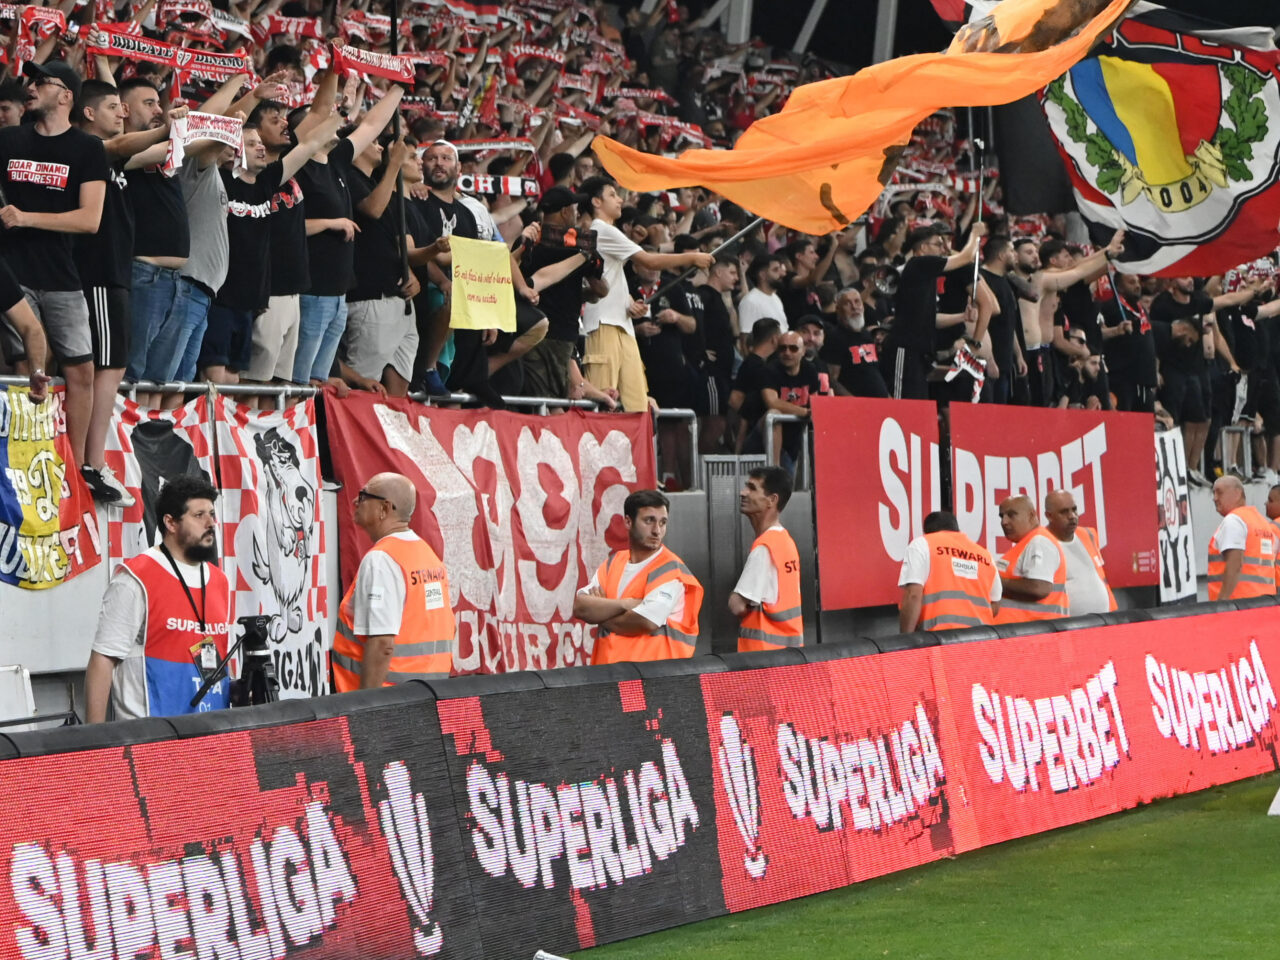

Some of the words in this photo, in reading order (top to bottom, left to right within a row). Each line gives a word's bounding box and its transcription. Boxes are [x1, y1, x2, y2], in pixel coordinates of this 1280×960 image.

[194, 53, 245, 69] DINAMO
[8, 159, 33, 171] DOAR
[35, 162, 68, 176] DINAMO
[10, 171, 62, 187] BUCURESTI
[166, 617, 230, 636] SUPERLIGA
[971, 659, 1130, 794] SUPERBET
[1149, 637, 1278, 753] SUPERLIGA
[465, 738, 700, 890] SUPERLIGA
[777, 702, 945, 832] SUPERLIGA
[9, 799, 359, 960] SUPERLIGA
